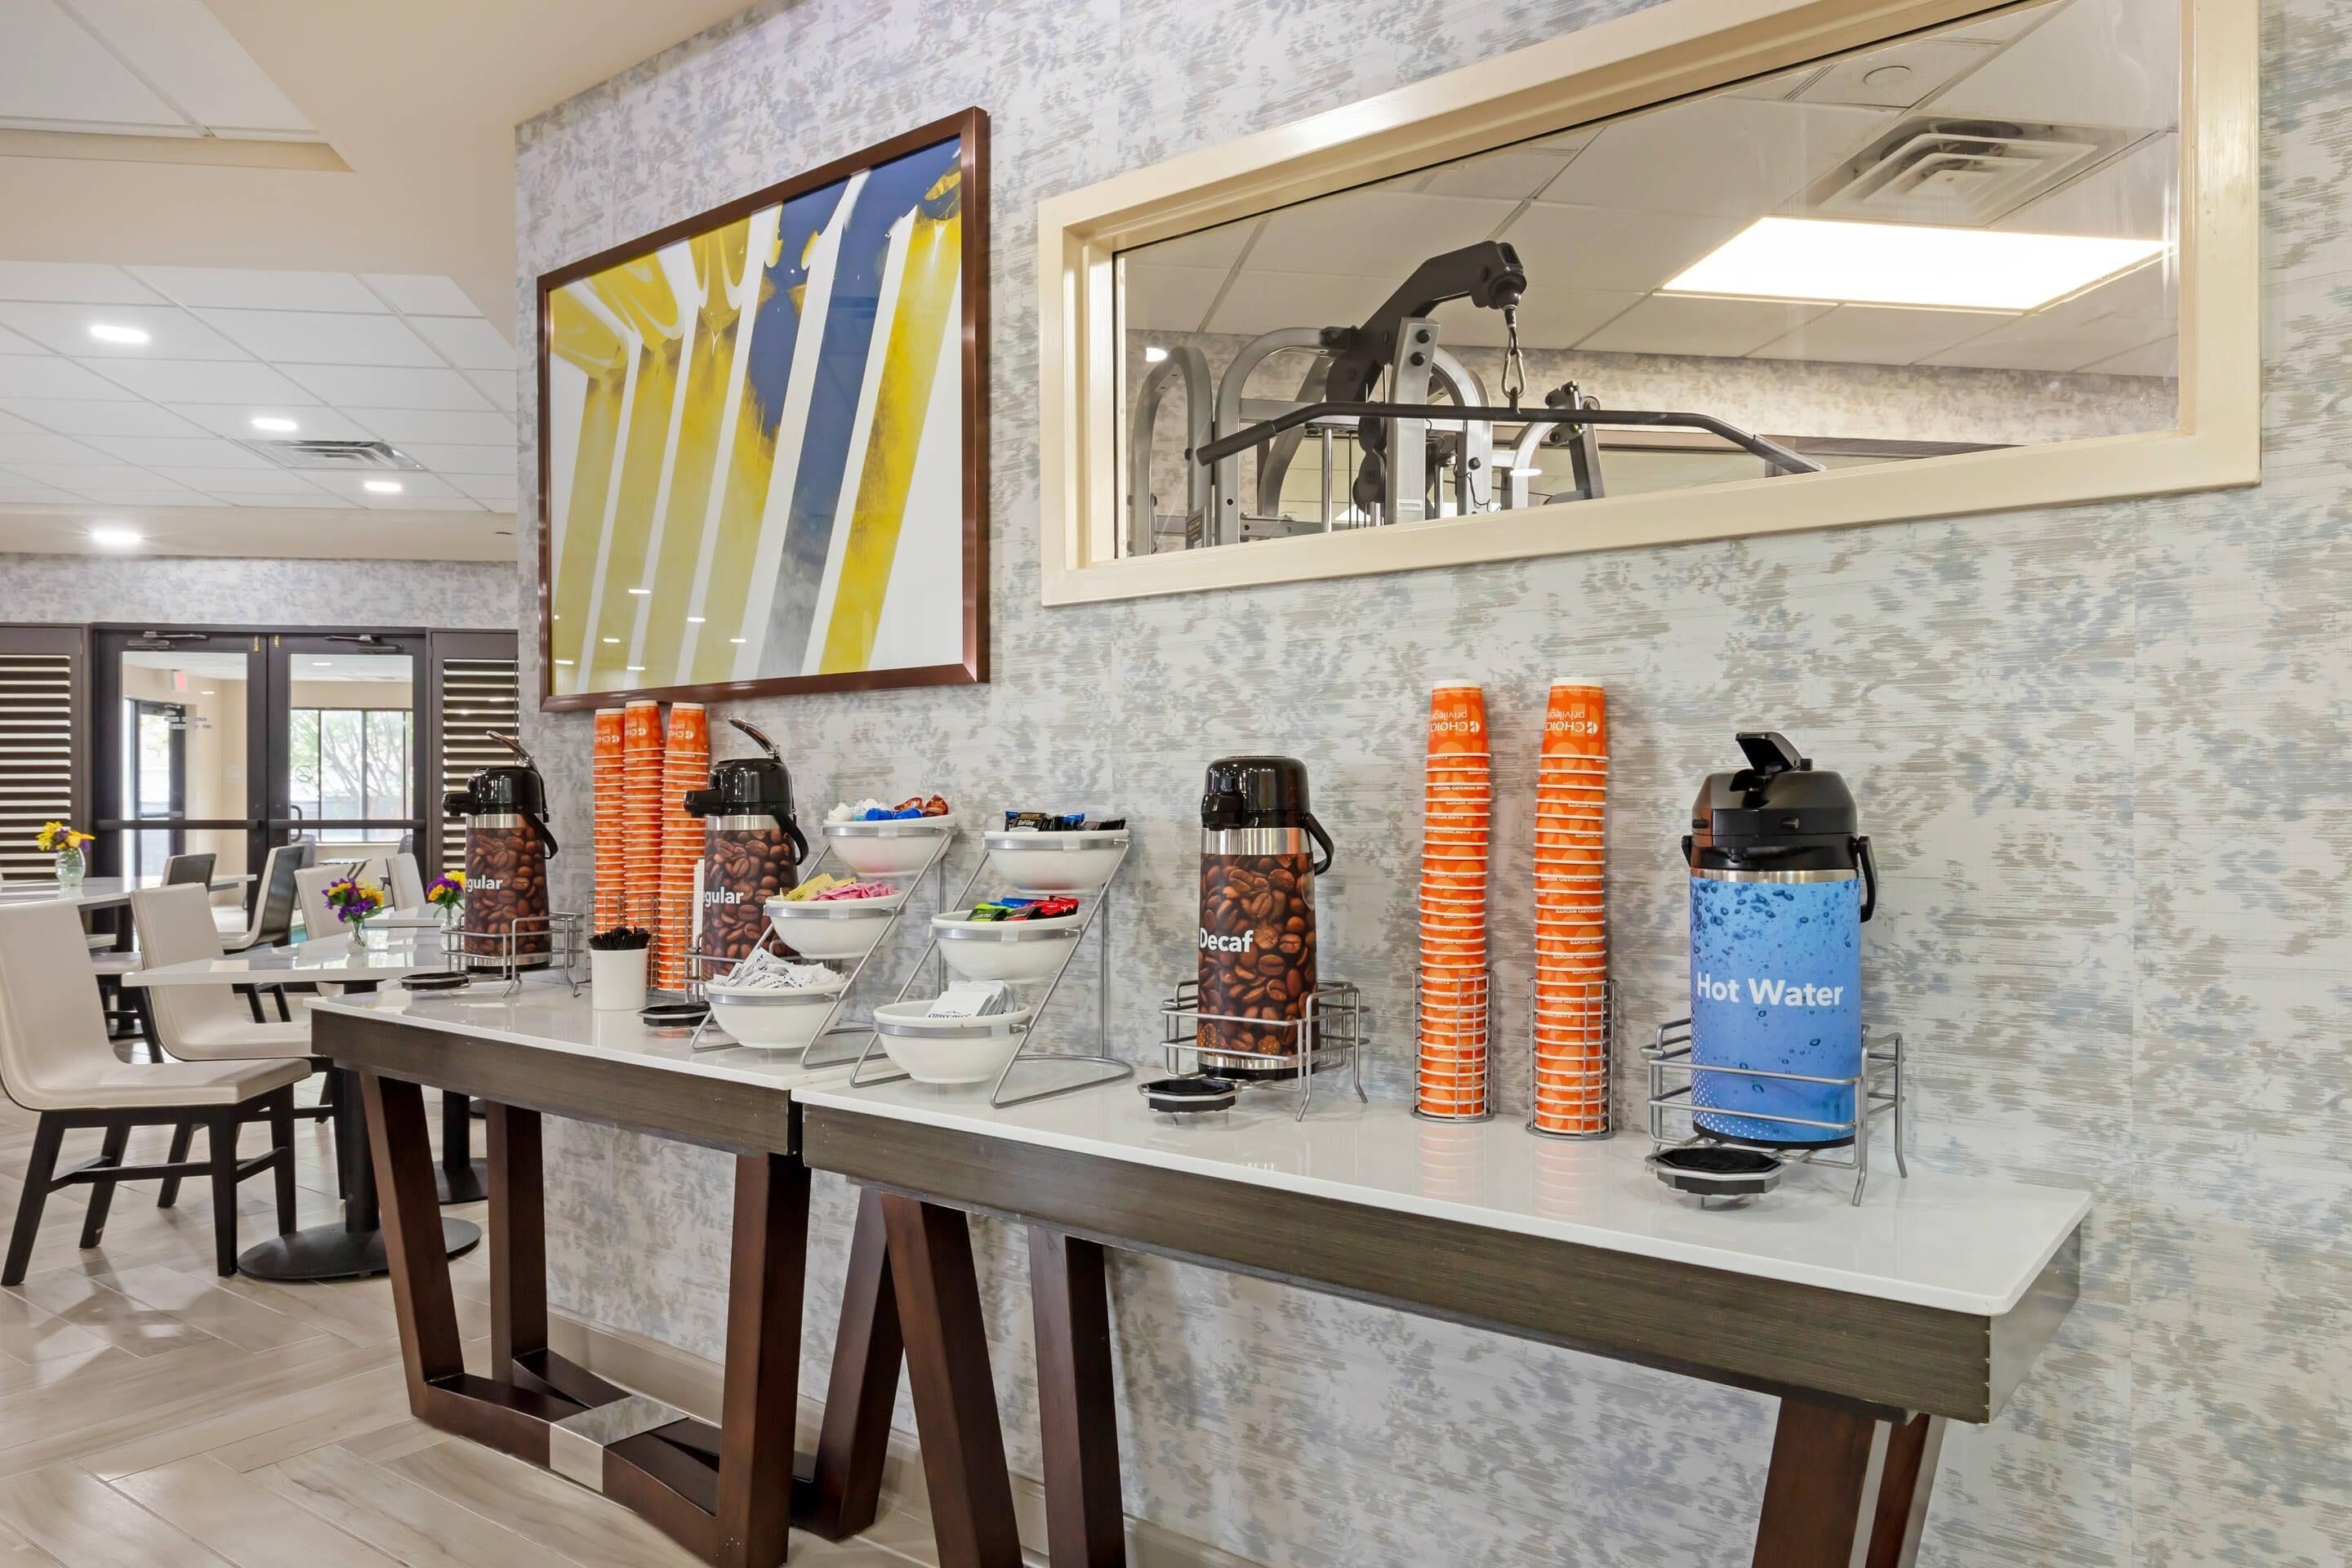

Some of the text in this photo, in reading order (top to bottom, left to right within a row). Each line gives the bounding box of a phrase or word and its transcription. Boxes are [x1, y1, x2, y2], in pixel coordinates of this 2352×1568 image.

[465, 875, 503, 893] gular
[703, 886, 744, 907] gular
[1200, 927, 1254, 953] Decaf
[1697, 972, 1843, 1007] Hot Water
